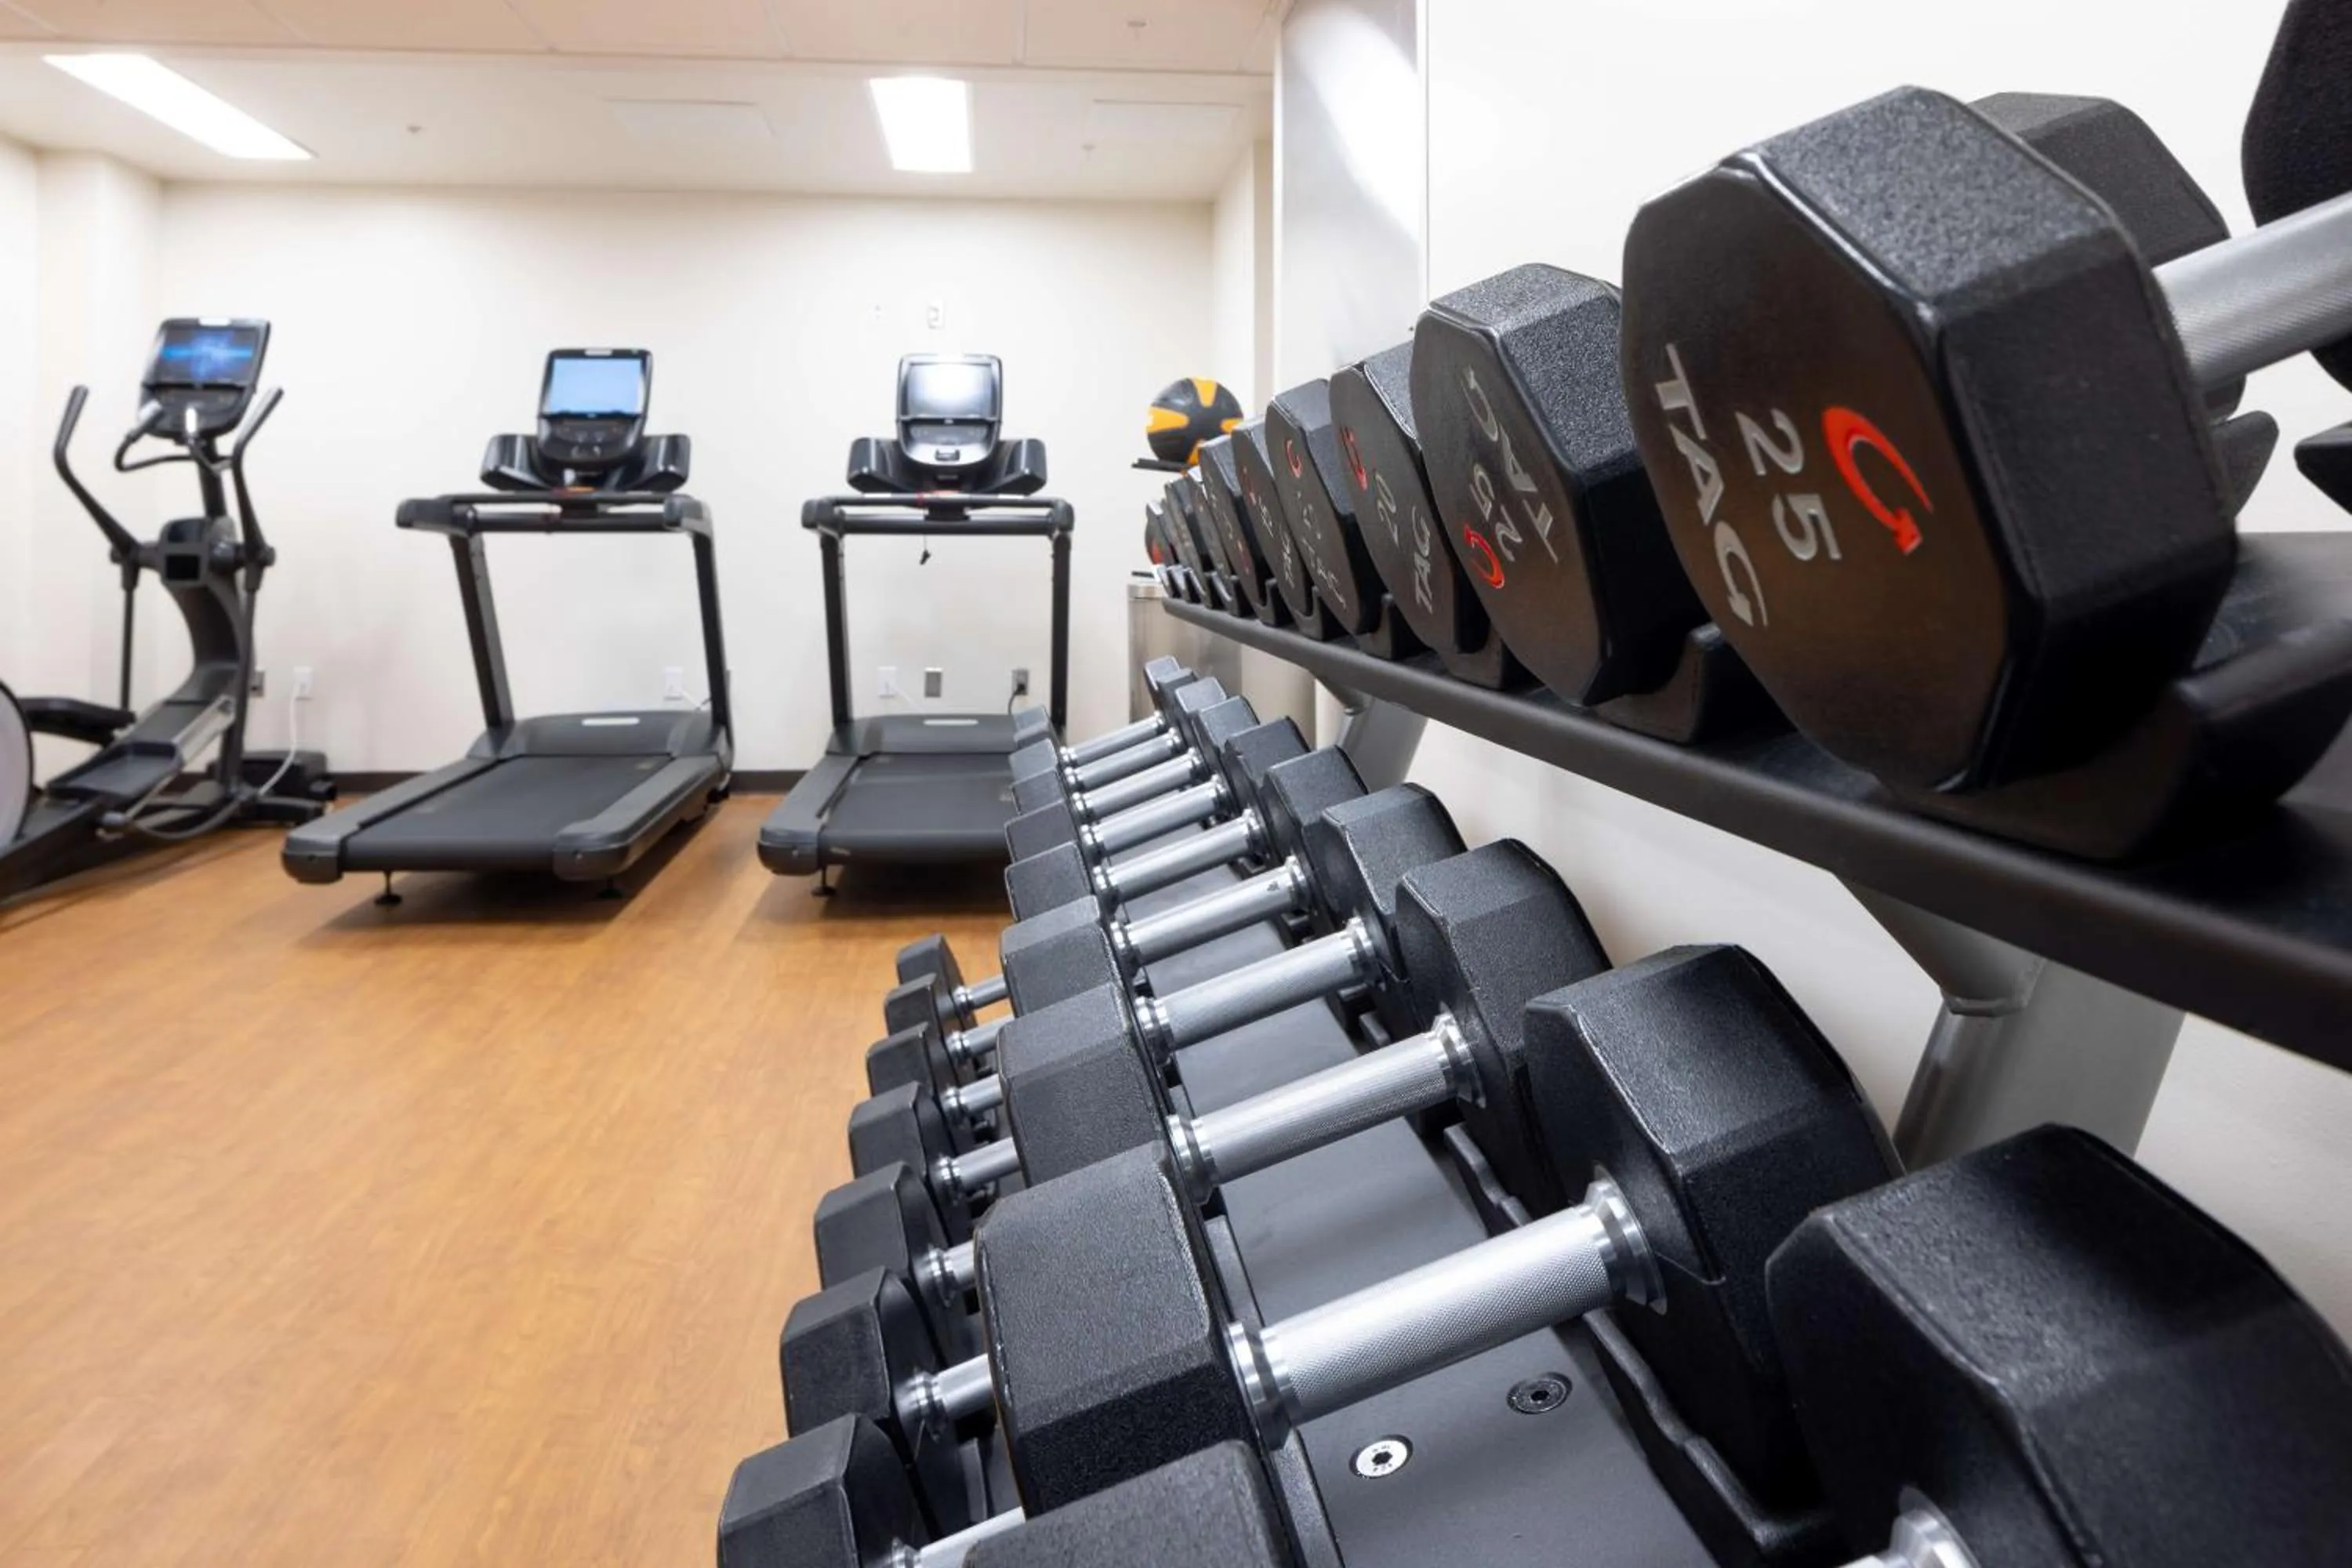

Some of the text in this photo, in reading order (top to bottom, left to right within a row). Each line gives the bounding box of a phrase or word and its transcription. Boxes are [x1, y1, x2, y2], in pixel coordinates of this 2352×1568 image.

[1374, 472, 1400, 548] 20
[1469, 463, 1523, 562] 25
[1735, 408, 1842, 561] 25
